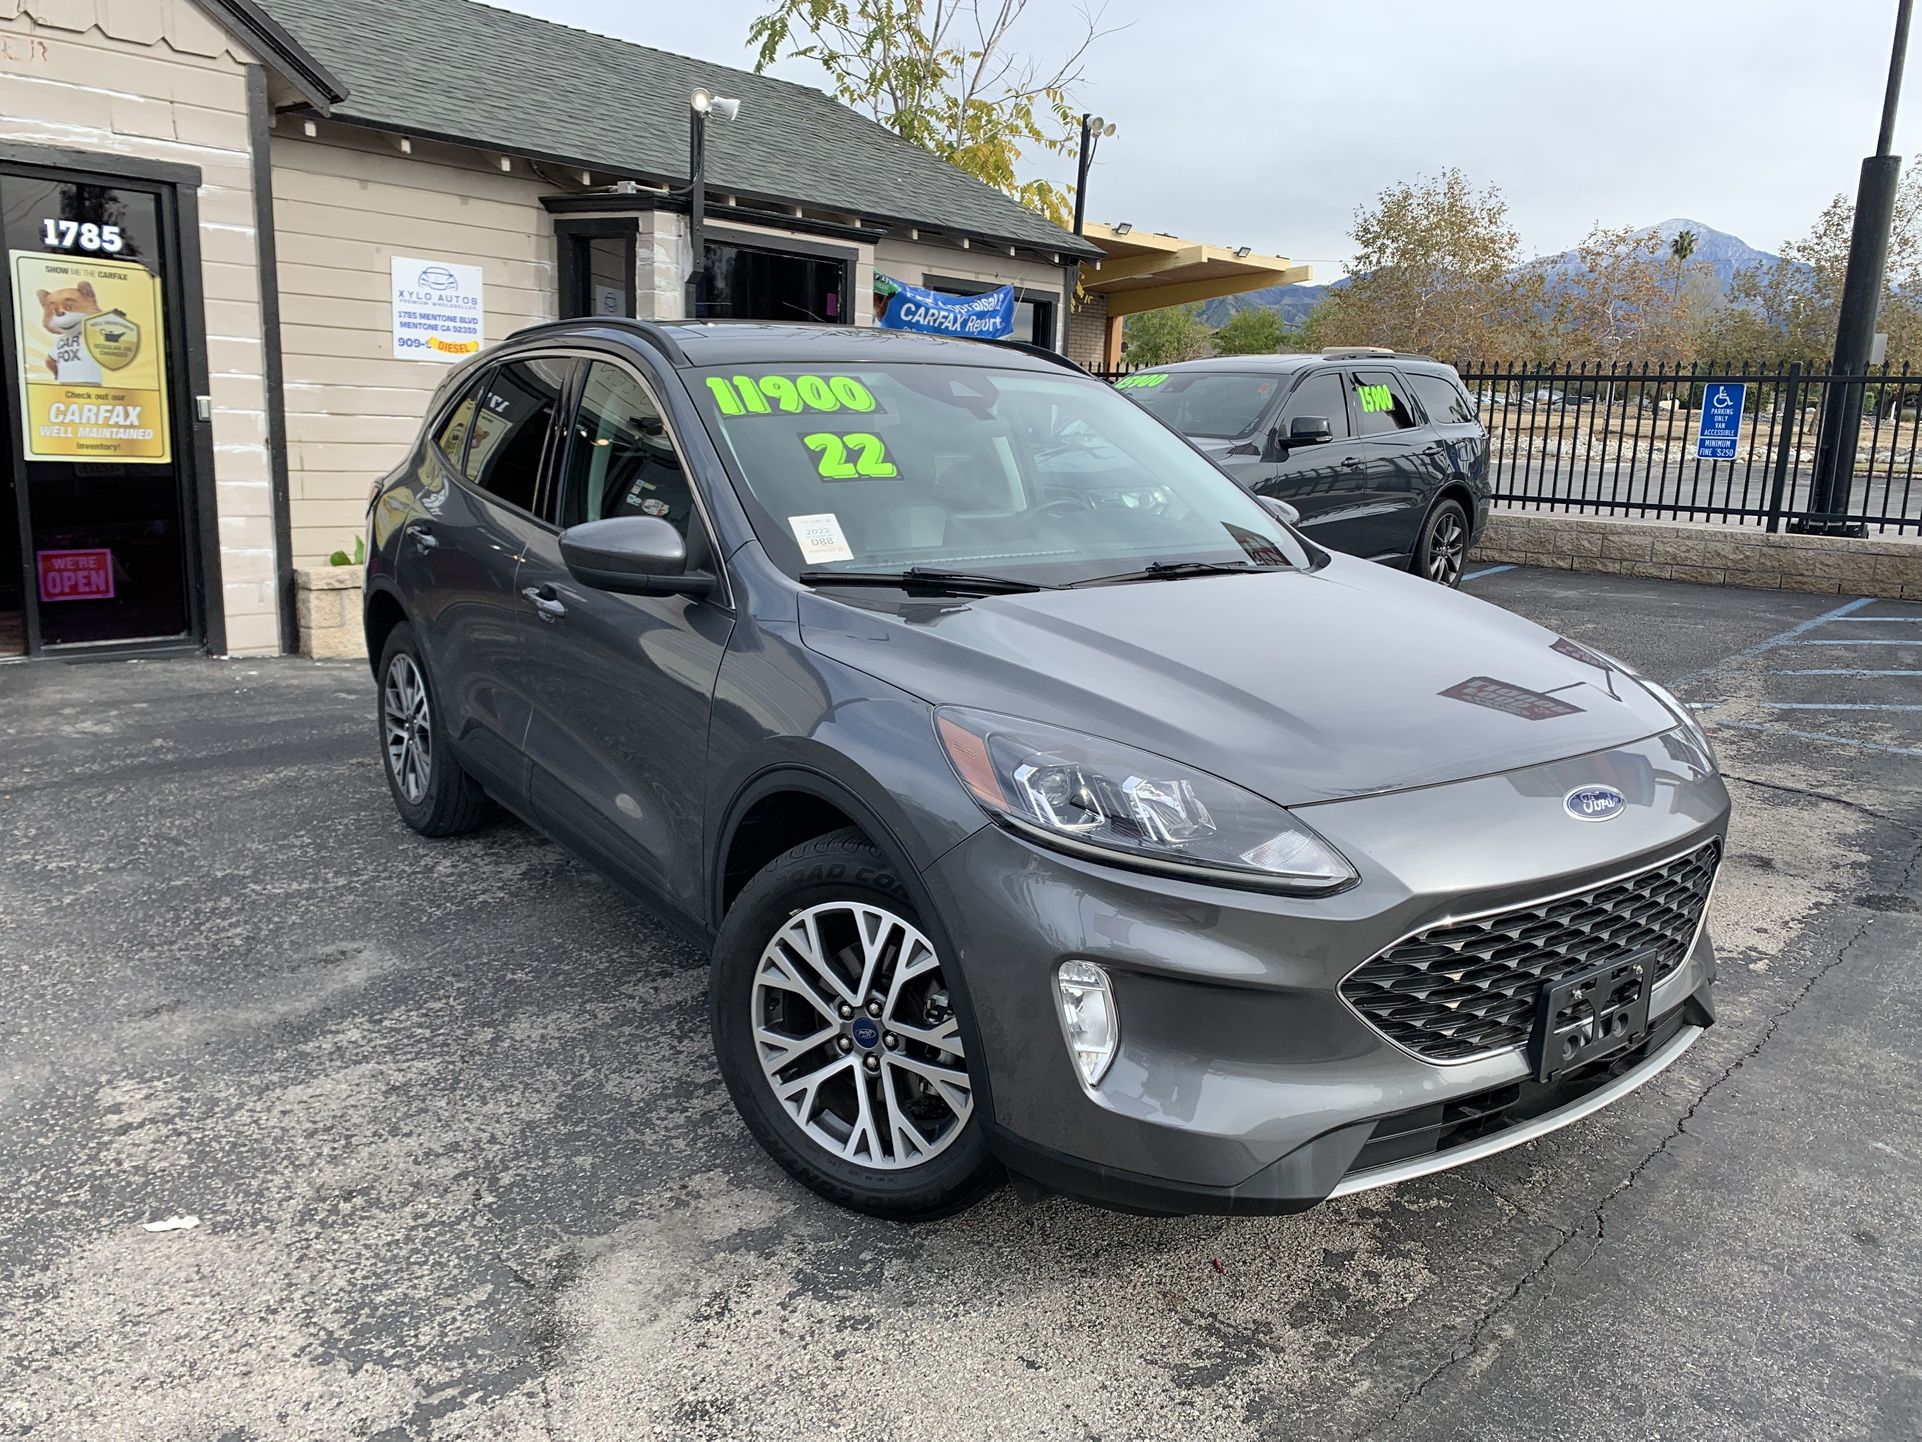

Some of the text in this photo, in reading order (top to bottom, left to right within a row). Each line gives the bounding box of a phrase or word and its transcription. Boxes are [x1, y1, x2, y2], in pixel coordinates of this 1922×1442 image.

[43, 218, 123, 253] 1785
[44, 265, 128, 281] SHOW ME THE CARFAX
[398, 290, 478, 306] XYLO AUTOS
[398, 311, 478, 325] 1785 MENTONE BLVD
[900, 302, 966, 332] CARFAX
[965, 315, 1003, 335] Report
[399, 321, 439, 331] MENTONE
[440, 324, 451, 332] CA
[56, 333, 80, 350] CAR
[437, 341, 471, 354] DIESEL
[56, 348, 82, 362] FOX
[64, 390, 92, 400] Check
[706, 375, 876, 415] 11900
[1359, 384, 1393, 413] 15900
[48, 401, 142, 426] CARFAX
[39, 424, 154, 440] WELL MAINTAINED
[76, 441, 121, 452] Inventory!
[1700, 448, 1713, 456] FINE
[1705, 440, 1731, 448] MINIMUM
[803, 433, 897, 478] 22
[806, 528, 830, 536] 2022
[51, 556, 97, 569] WE'RE
[47, 569, 106, 593] OPEN
[1579, 790, 1616, 814] Ford
